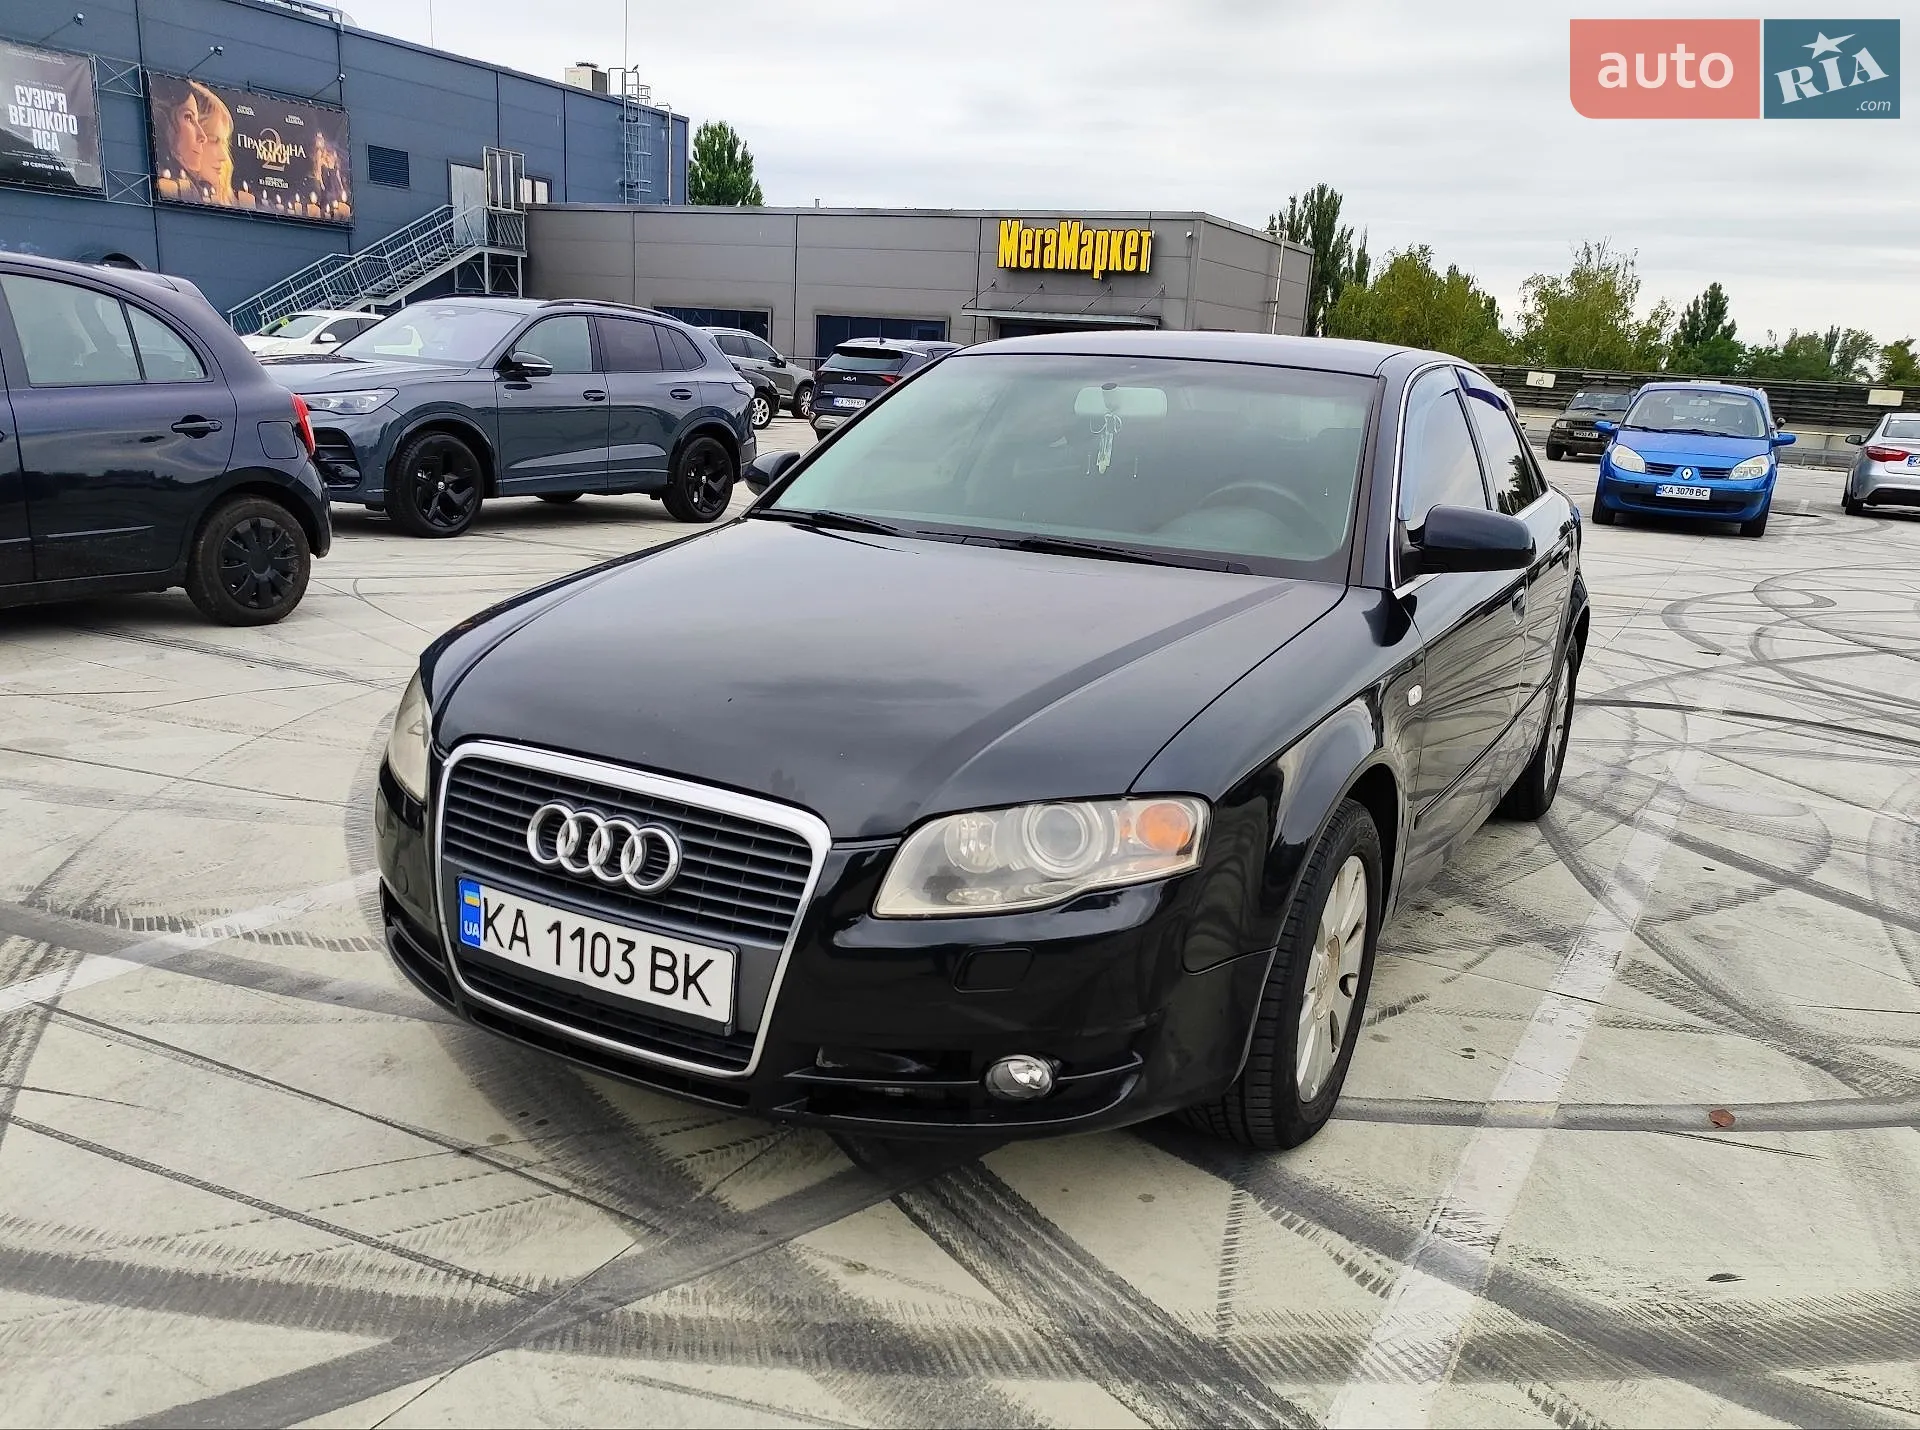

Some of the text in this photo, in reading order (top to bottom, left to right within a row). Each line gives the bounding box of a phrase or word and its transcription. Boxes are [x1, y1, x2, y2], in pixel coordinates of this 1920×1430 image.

[14, 84, 68, 113] СУЗІР'Я
[8, 103, 78, 135] ВЕЛИКОГО
[32, 128, 60, 152] ПСА
[997, 220, 1152, 280] МегаМаркет
[1662, 486, 1674, 495] KA
[1695, 488, 1708, 497] BC
[464, 920, 480, 938] UA
[483, 897, 715, 1007] KA 1103 BK
